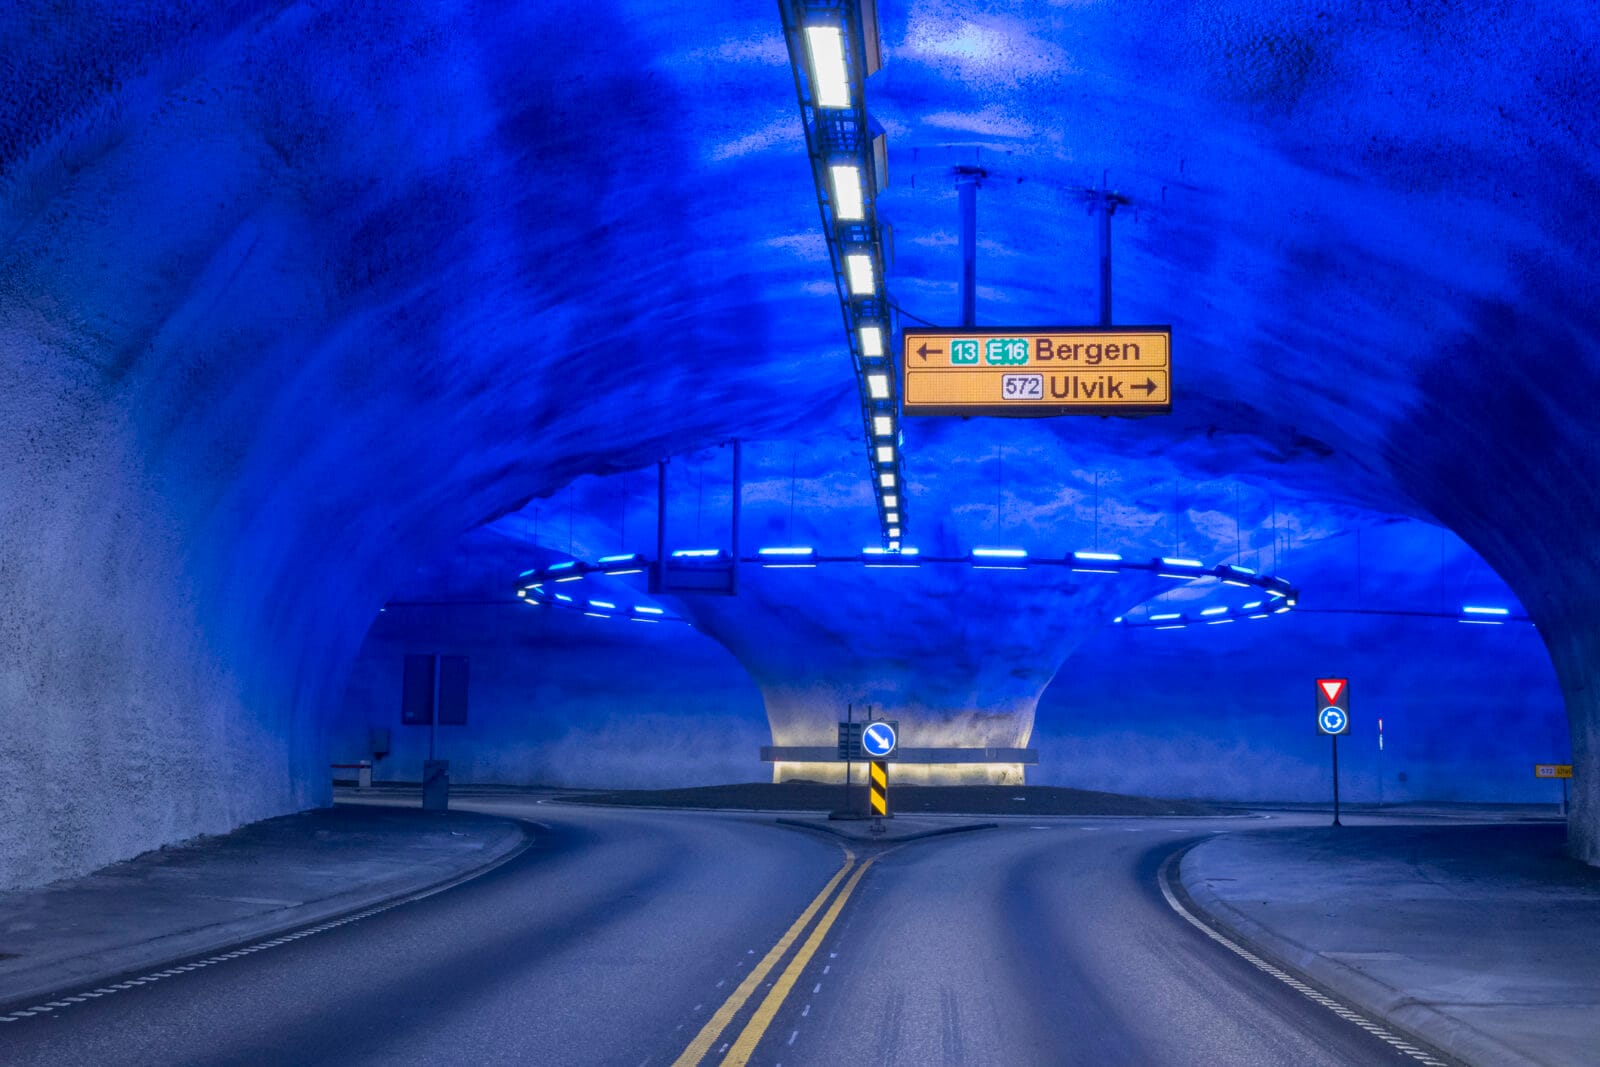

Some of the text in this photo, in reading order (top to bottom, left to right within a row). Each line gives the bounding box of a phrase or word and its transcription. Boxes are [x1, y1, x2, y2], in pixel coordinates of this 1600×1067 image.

[954, 338, 1140, 365] 13 E16 Bergen
[1006, 376, 1124, 398] 572 Ulvik
